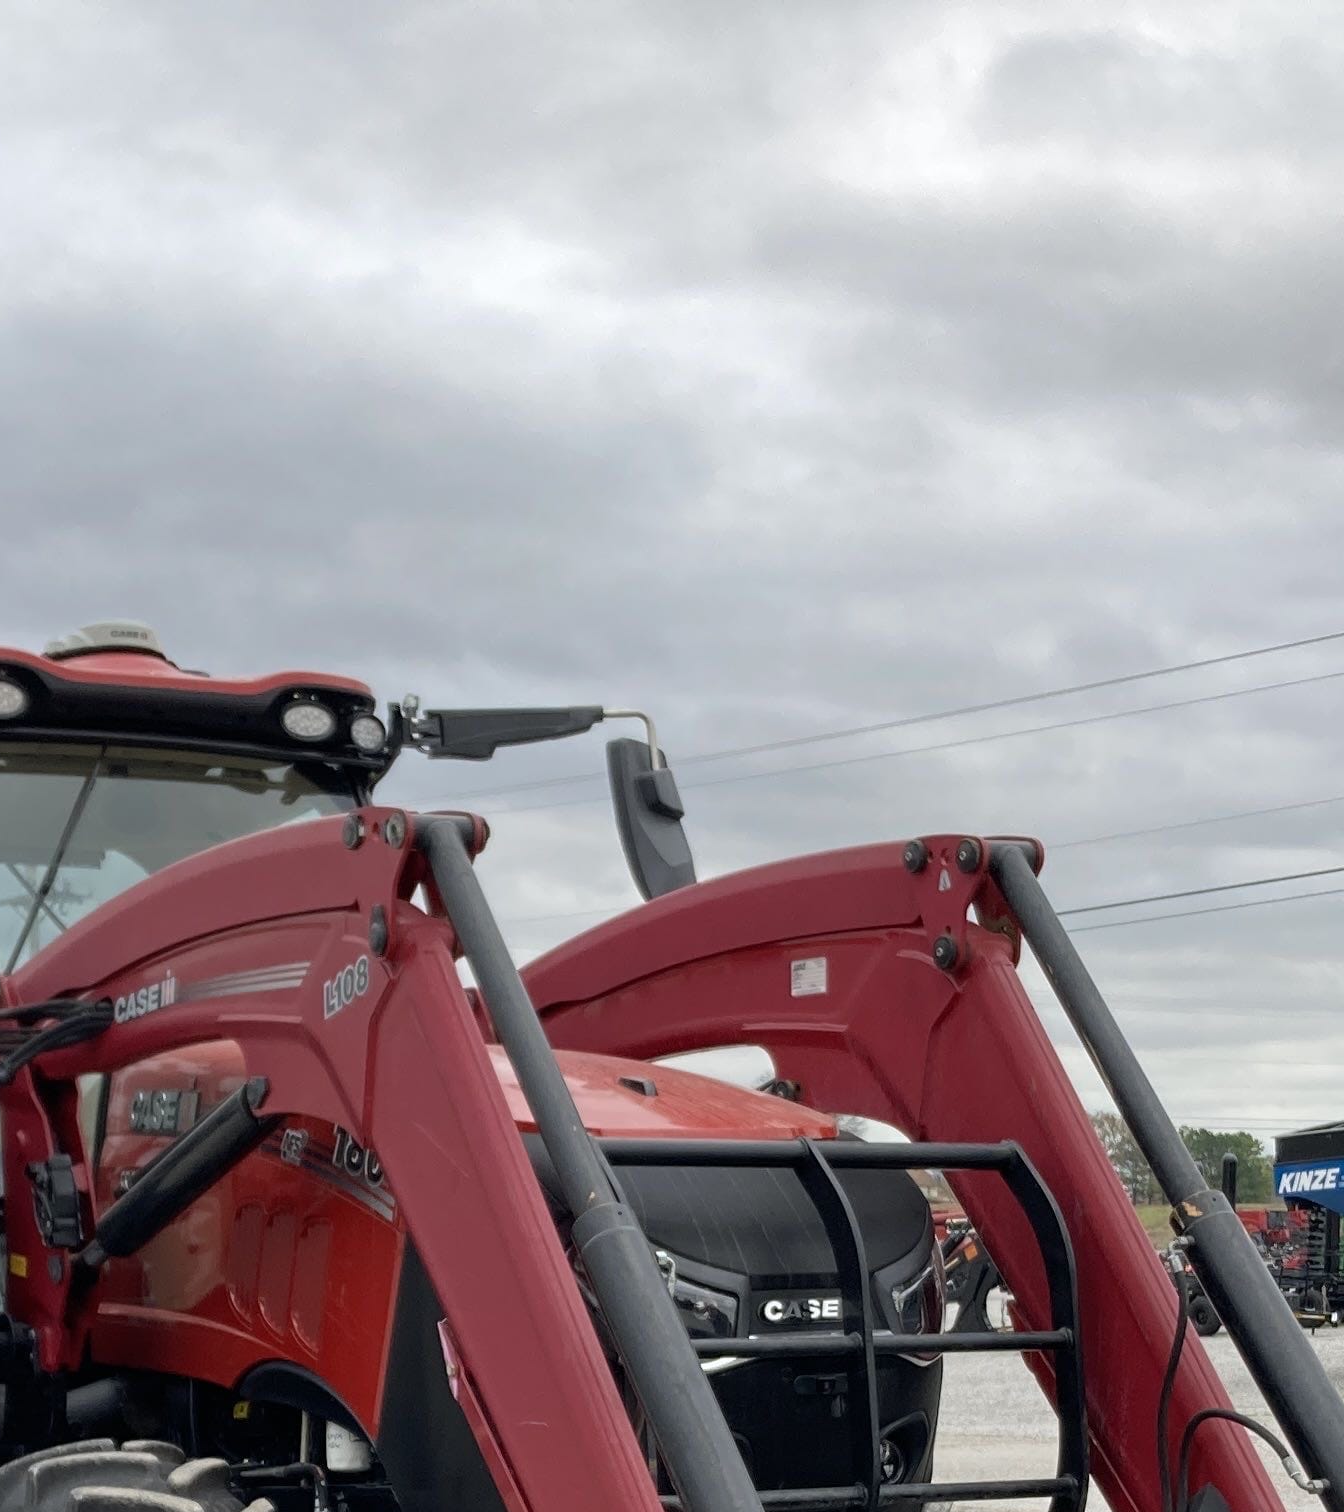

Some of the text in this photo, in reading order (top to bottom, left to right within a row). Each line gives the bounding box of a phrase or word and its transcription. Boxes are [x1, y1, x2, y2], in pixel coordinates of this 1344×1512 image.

[114, 983, 160, 1025] CASE
[323, 954, 369, 1020] L108
[1278, 1167, 1341, 1195] KINZE
[764, 1299, 840, 1322] CASE
